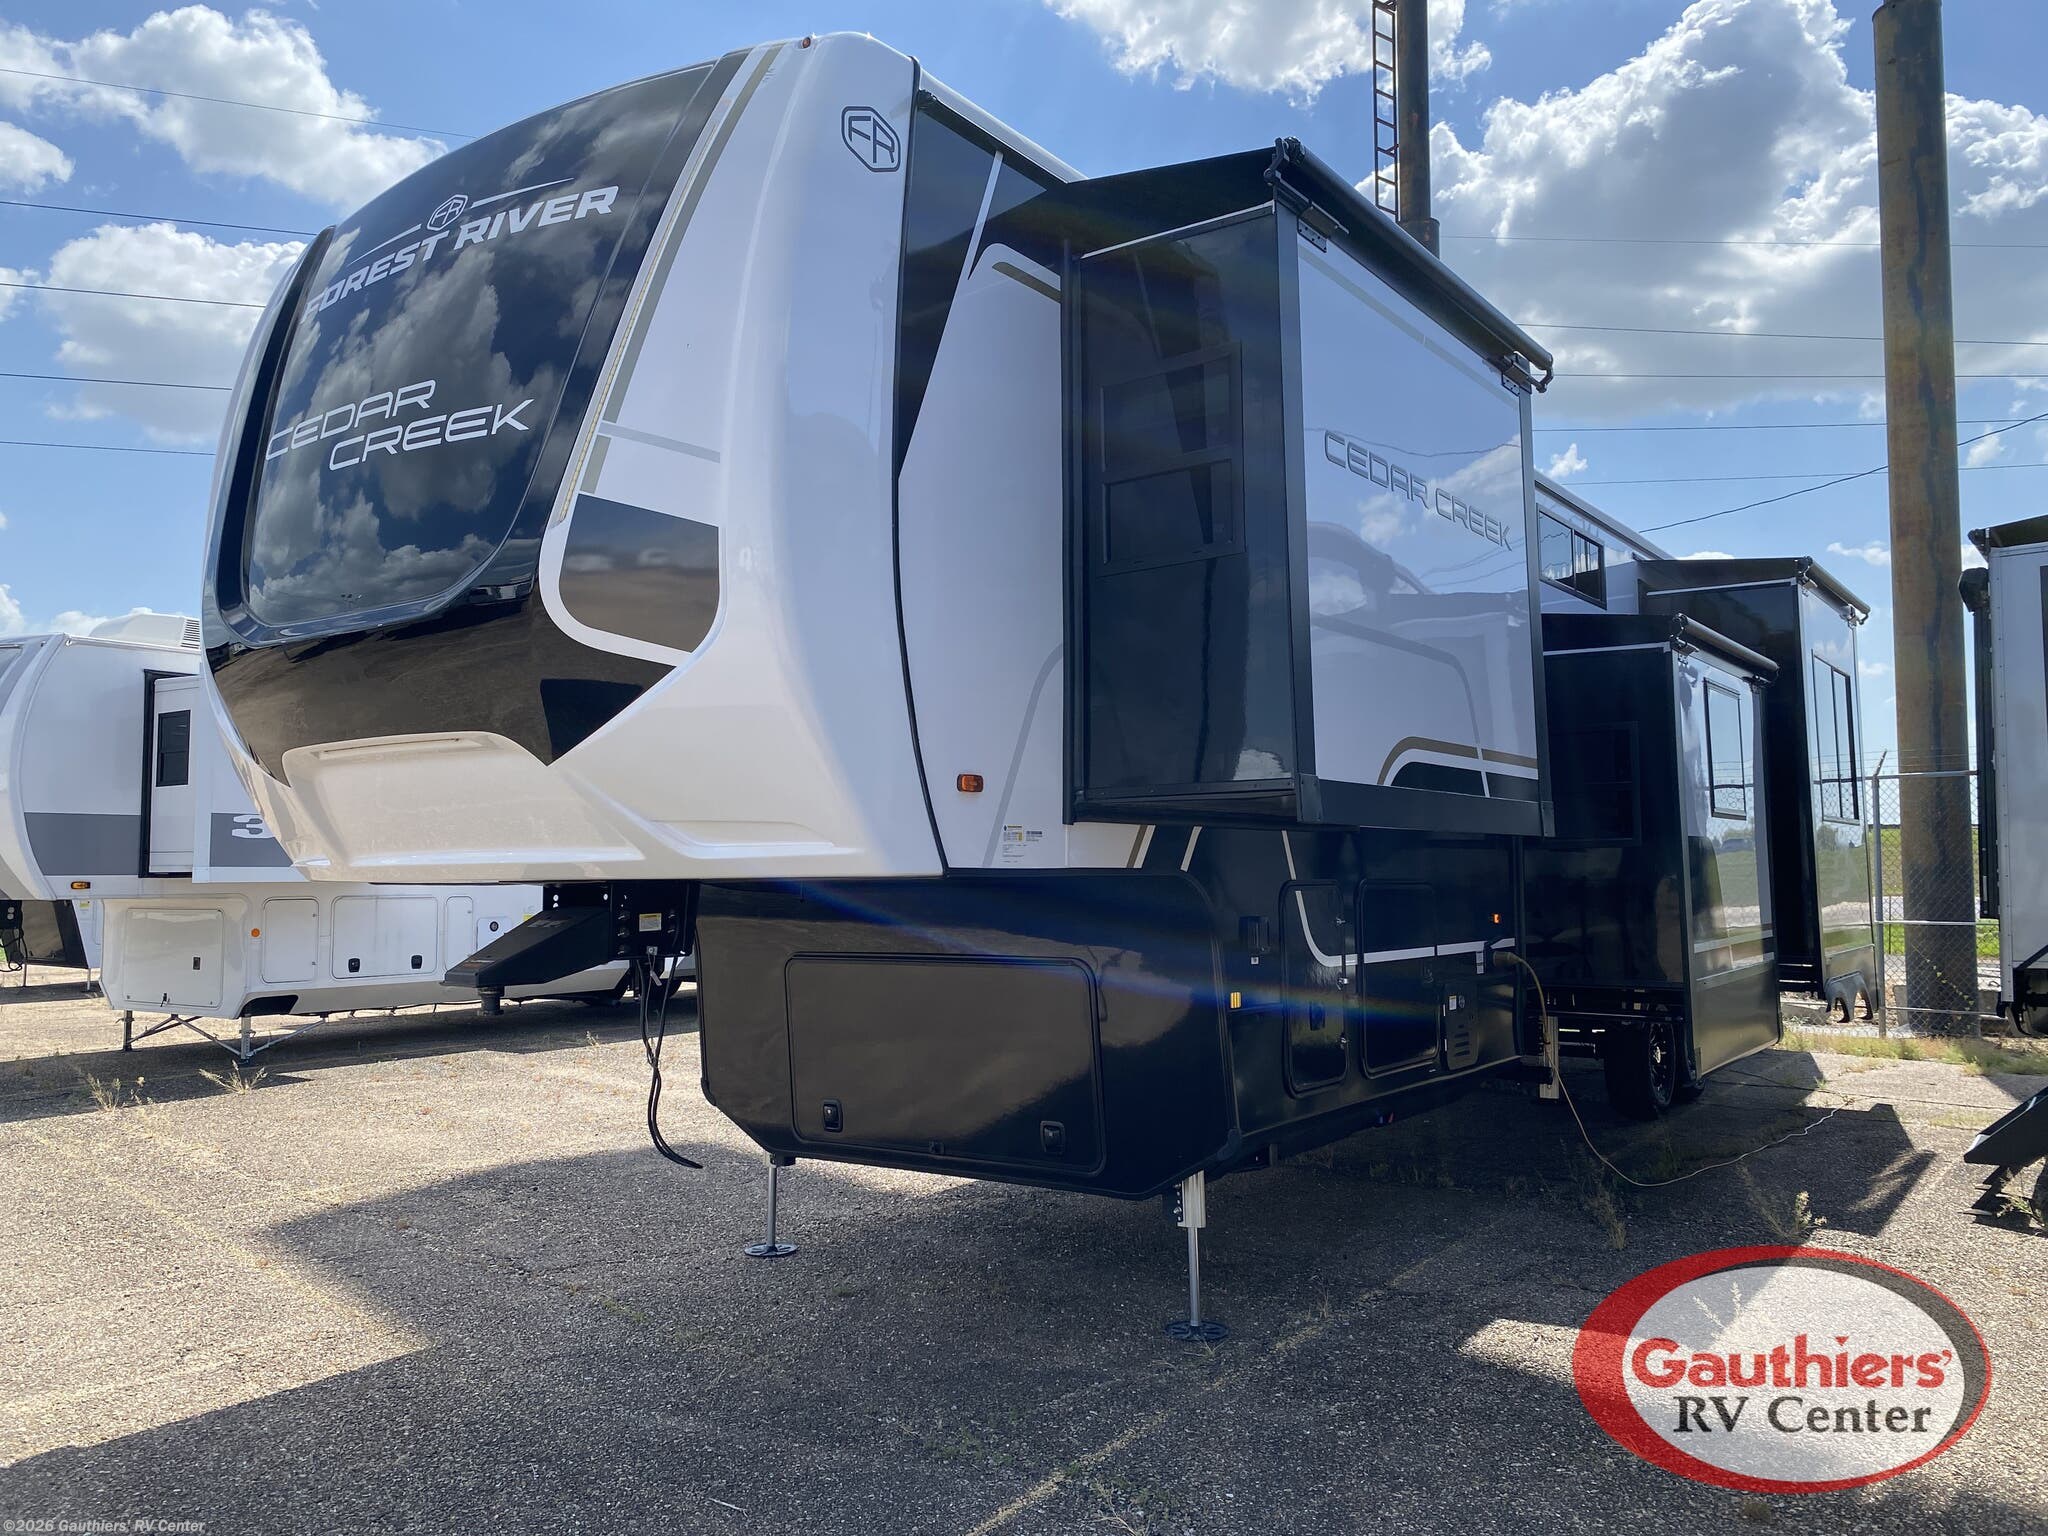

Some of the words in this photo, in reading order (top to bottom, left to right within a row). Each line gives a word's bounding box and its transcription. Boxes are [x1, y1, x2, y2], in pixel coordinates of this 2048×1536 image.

[300, 231, 449, 324] FOREST
[454, 186, 619, 250] RIVER
[265, 379, 436, 461] CEDAR
[329, 399, 535, 470] CREEK
[1324, 429, 1429, 509] CEDAR
[1434, 486, 1513, 552] CREEK
